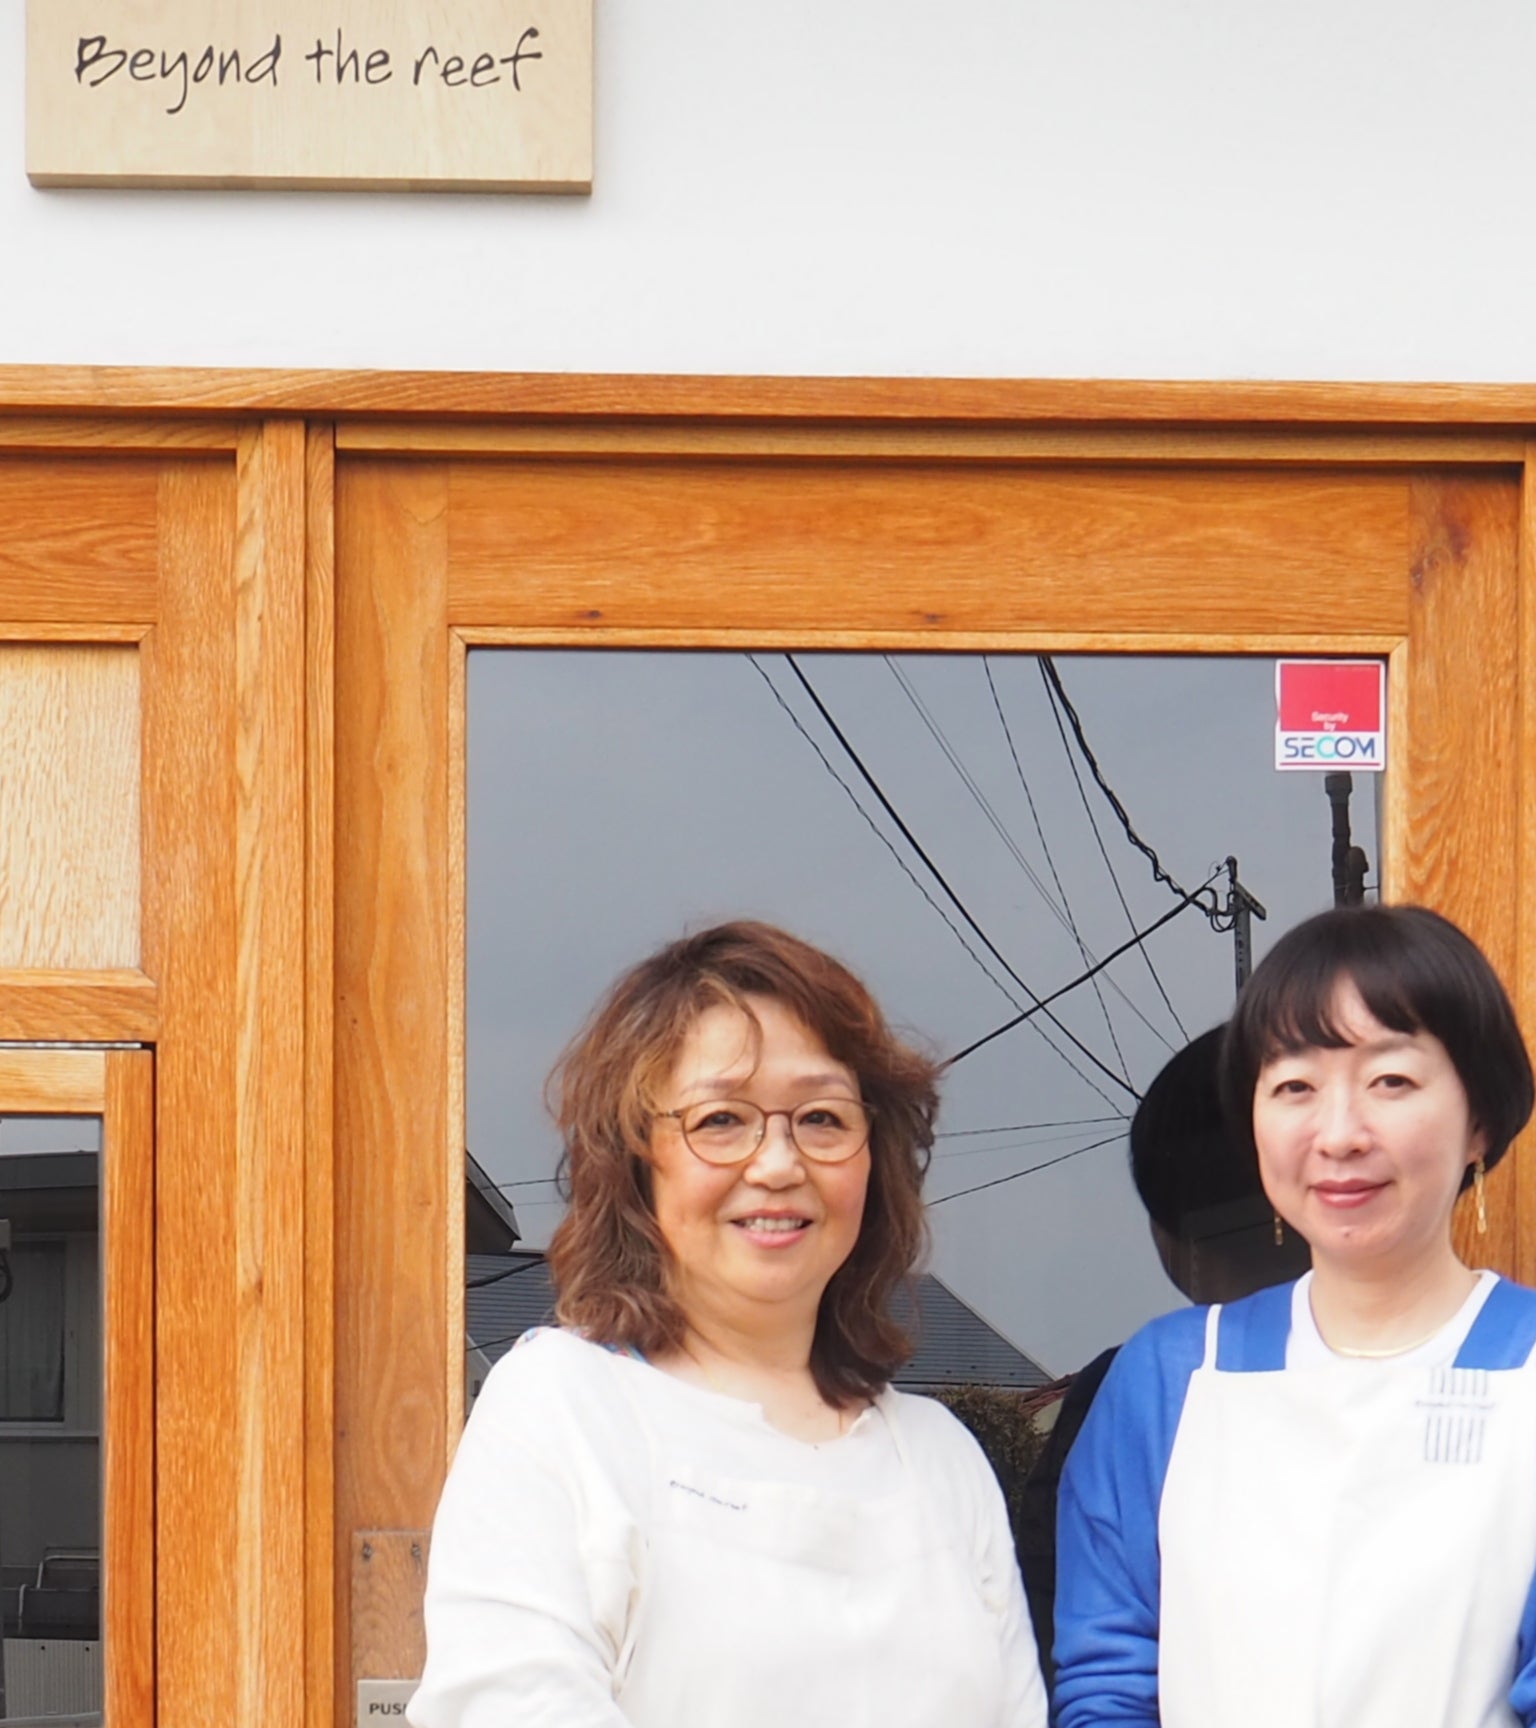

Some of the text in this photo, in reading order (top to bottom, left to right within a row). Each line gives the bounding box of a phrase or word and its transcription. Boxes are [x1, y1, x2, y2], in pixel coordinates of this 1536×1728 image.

[74, 26, 543, 115] Beyond the reef
[1284, 735, 1376, 759] SECOM
